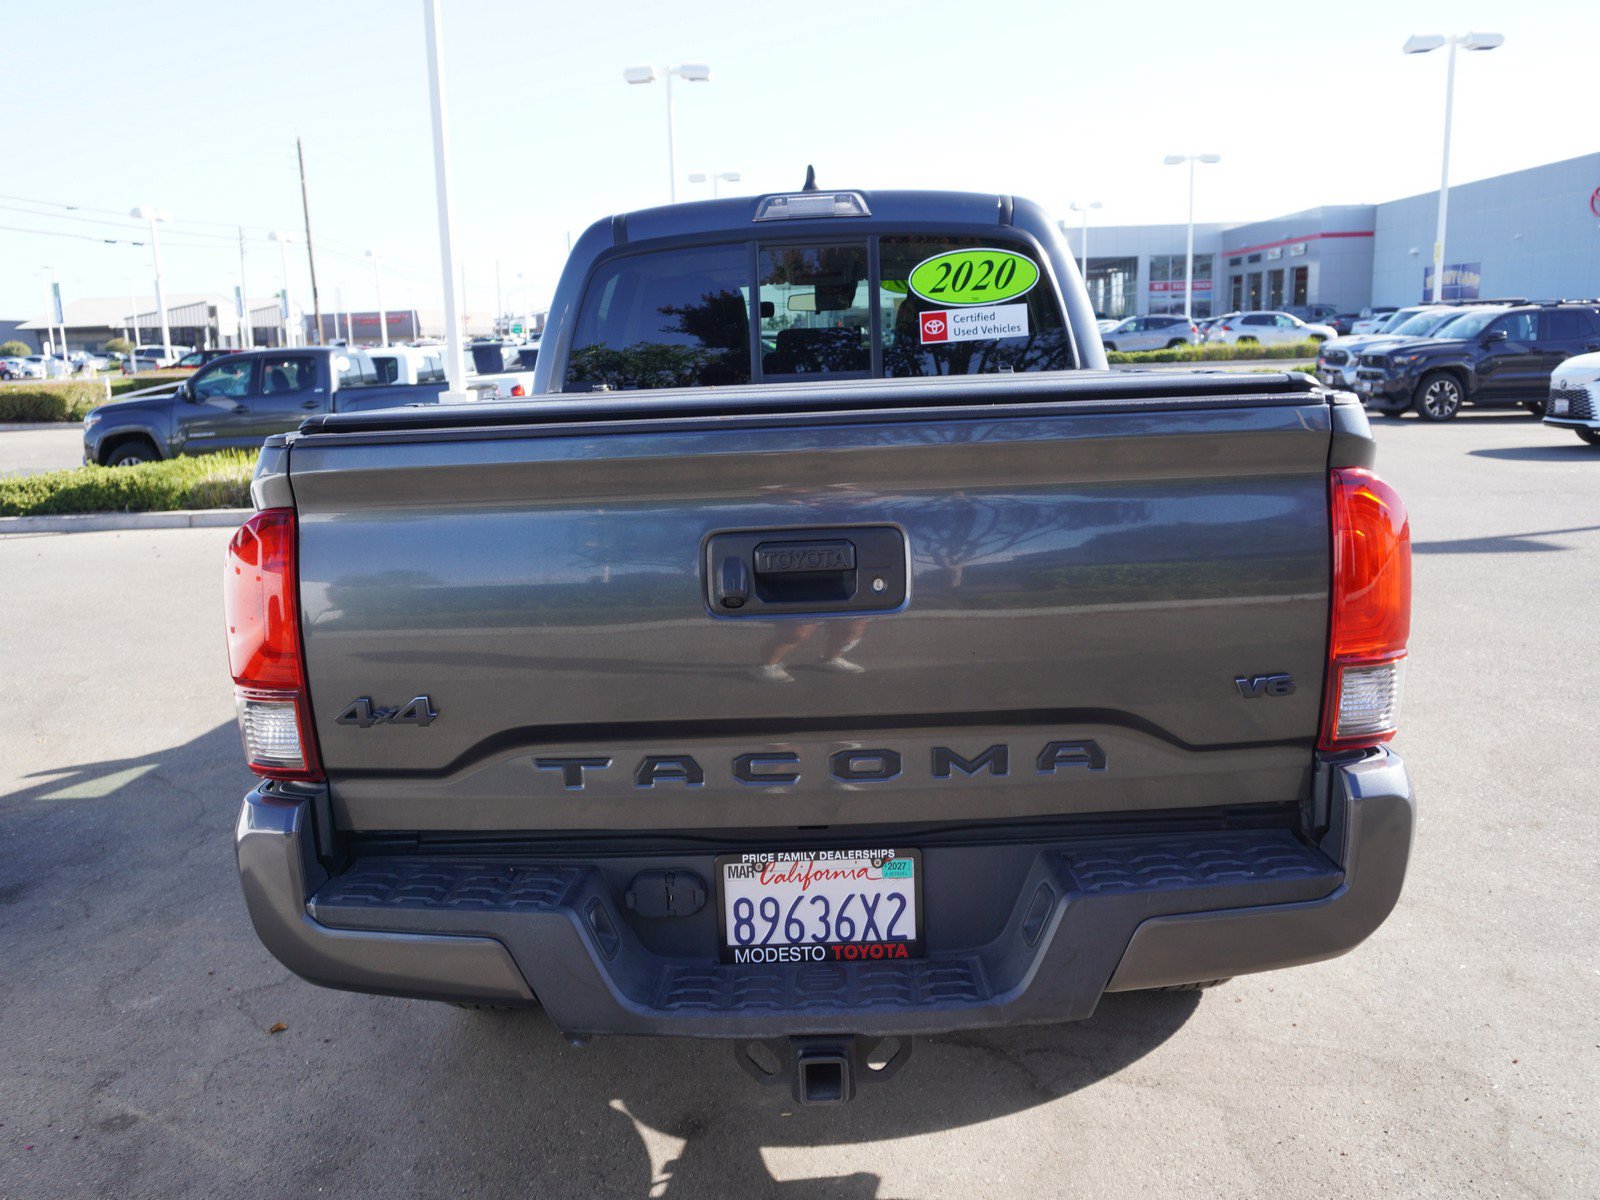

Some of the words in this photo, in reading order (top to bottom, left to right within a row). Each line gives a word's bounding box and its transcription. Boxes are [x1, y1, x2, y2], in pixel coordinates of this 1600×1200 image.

[929, 258, 1016, 293] 2020
[953, 312, 996, 324] Certified
[954, 325, 978, 336] Used
[981, 323, 1021, 335] Vehicles
[763, 549, 848, 570] TOYOTA
[1234, 673, 1296, 698] V6
[534, 739, 1107, 790] TACOMA
[742, 853, 775, 863] PRICE
[778, 852, 816, 862] FAMILY
[820, 849, 895, 861] DEALERSHIPS
[728, 865, 755, 879] MAR
[760, 859, 882, 891] California
[888, 862, 906, 870] 2027
[733, 892, 907, 944] 89636X2
[735, 946, 825, 963] MODESTO
[832, 943, 909, 960] TOYOTA
